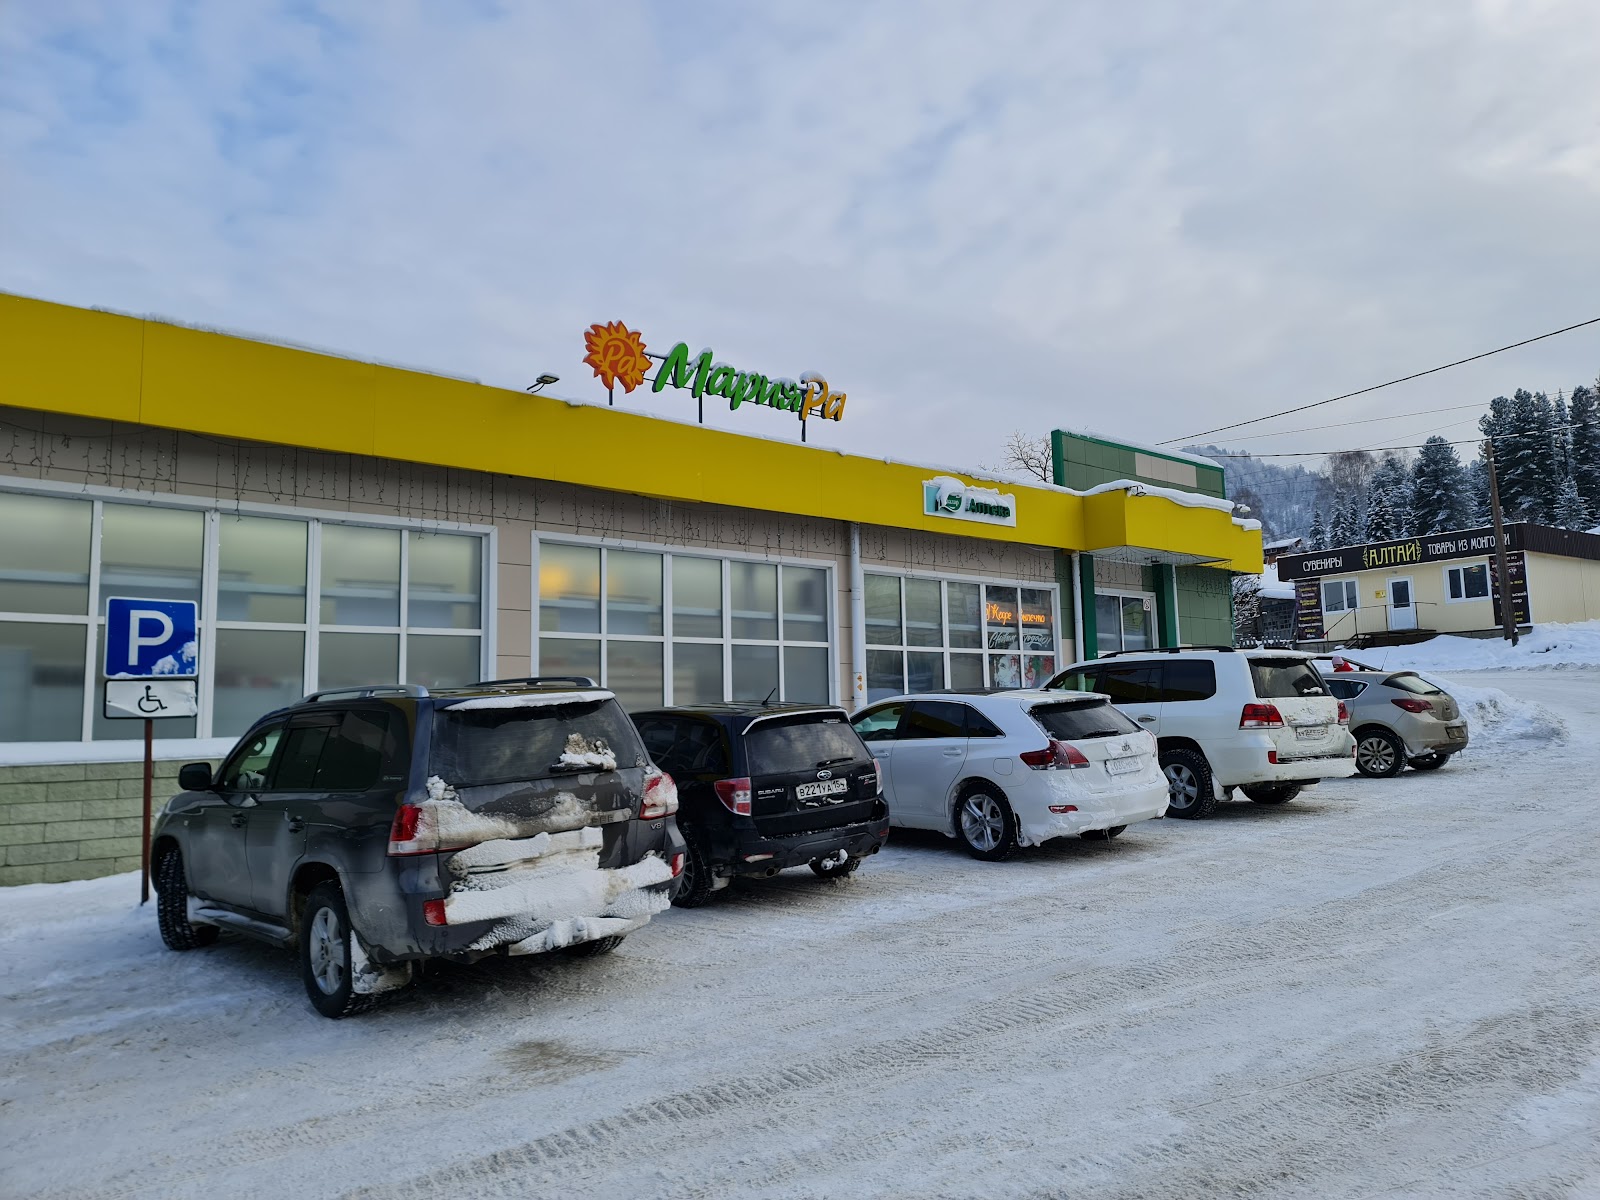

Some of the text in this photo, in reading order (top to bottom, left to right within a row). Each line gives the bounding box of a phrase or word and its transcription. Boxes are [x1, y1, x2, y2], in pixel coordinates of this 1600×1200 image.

[603, 340, 635, 373] Ра
[968, 498, 1011, 518] Аптека
[1369, 542, 1417, 567] АЛТАЙ
[1427, 533, 1511, 556] ТОВАРЫ ИЗ МОНГОИ
[1302, 556, 1343, 572] СУВЕНИРЫ
[127, 609, 174, 666] P
[757, 787, 785, 796] SUBARU
[651, 822, 662, 830] V8
